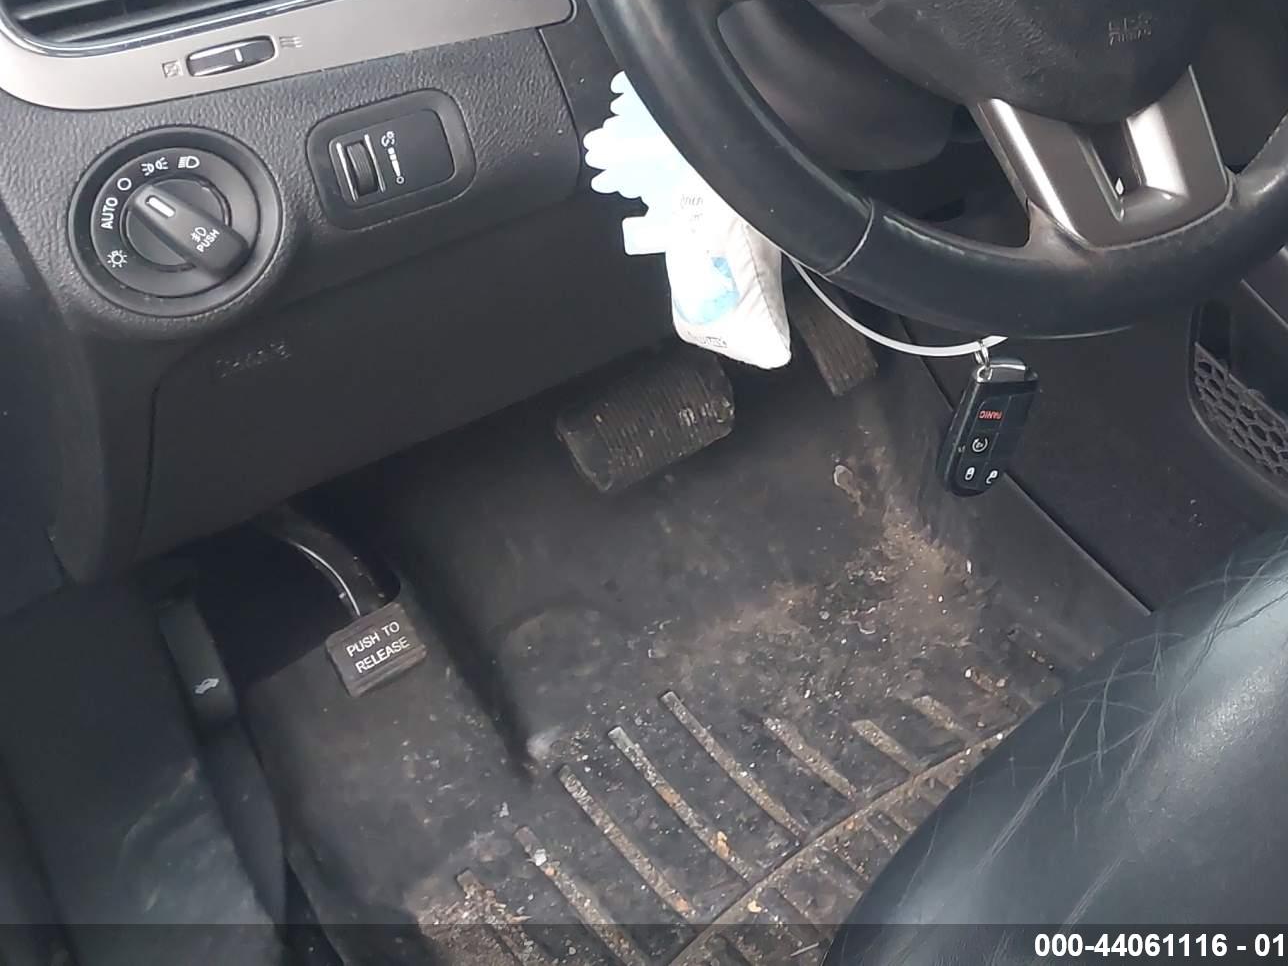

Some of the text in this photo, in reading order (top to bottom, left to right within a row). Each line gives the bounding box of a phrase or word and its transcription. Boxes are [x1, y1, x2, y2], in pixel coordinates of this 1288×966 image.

[101, 196, 118, 230] AUTO
[196, 228, 220, 253] PUSH
[979, 410, 1002, 419] PANIC
[346, 621, 400, 657] PUSH TO
[355, 636, 410, 673] RELEASE
